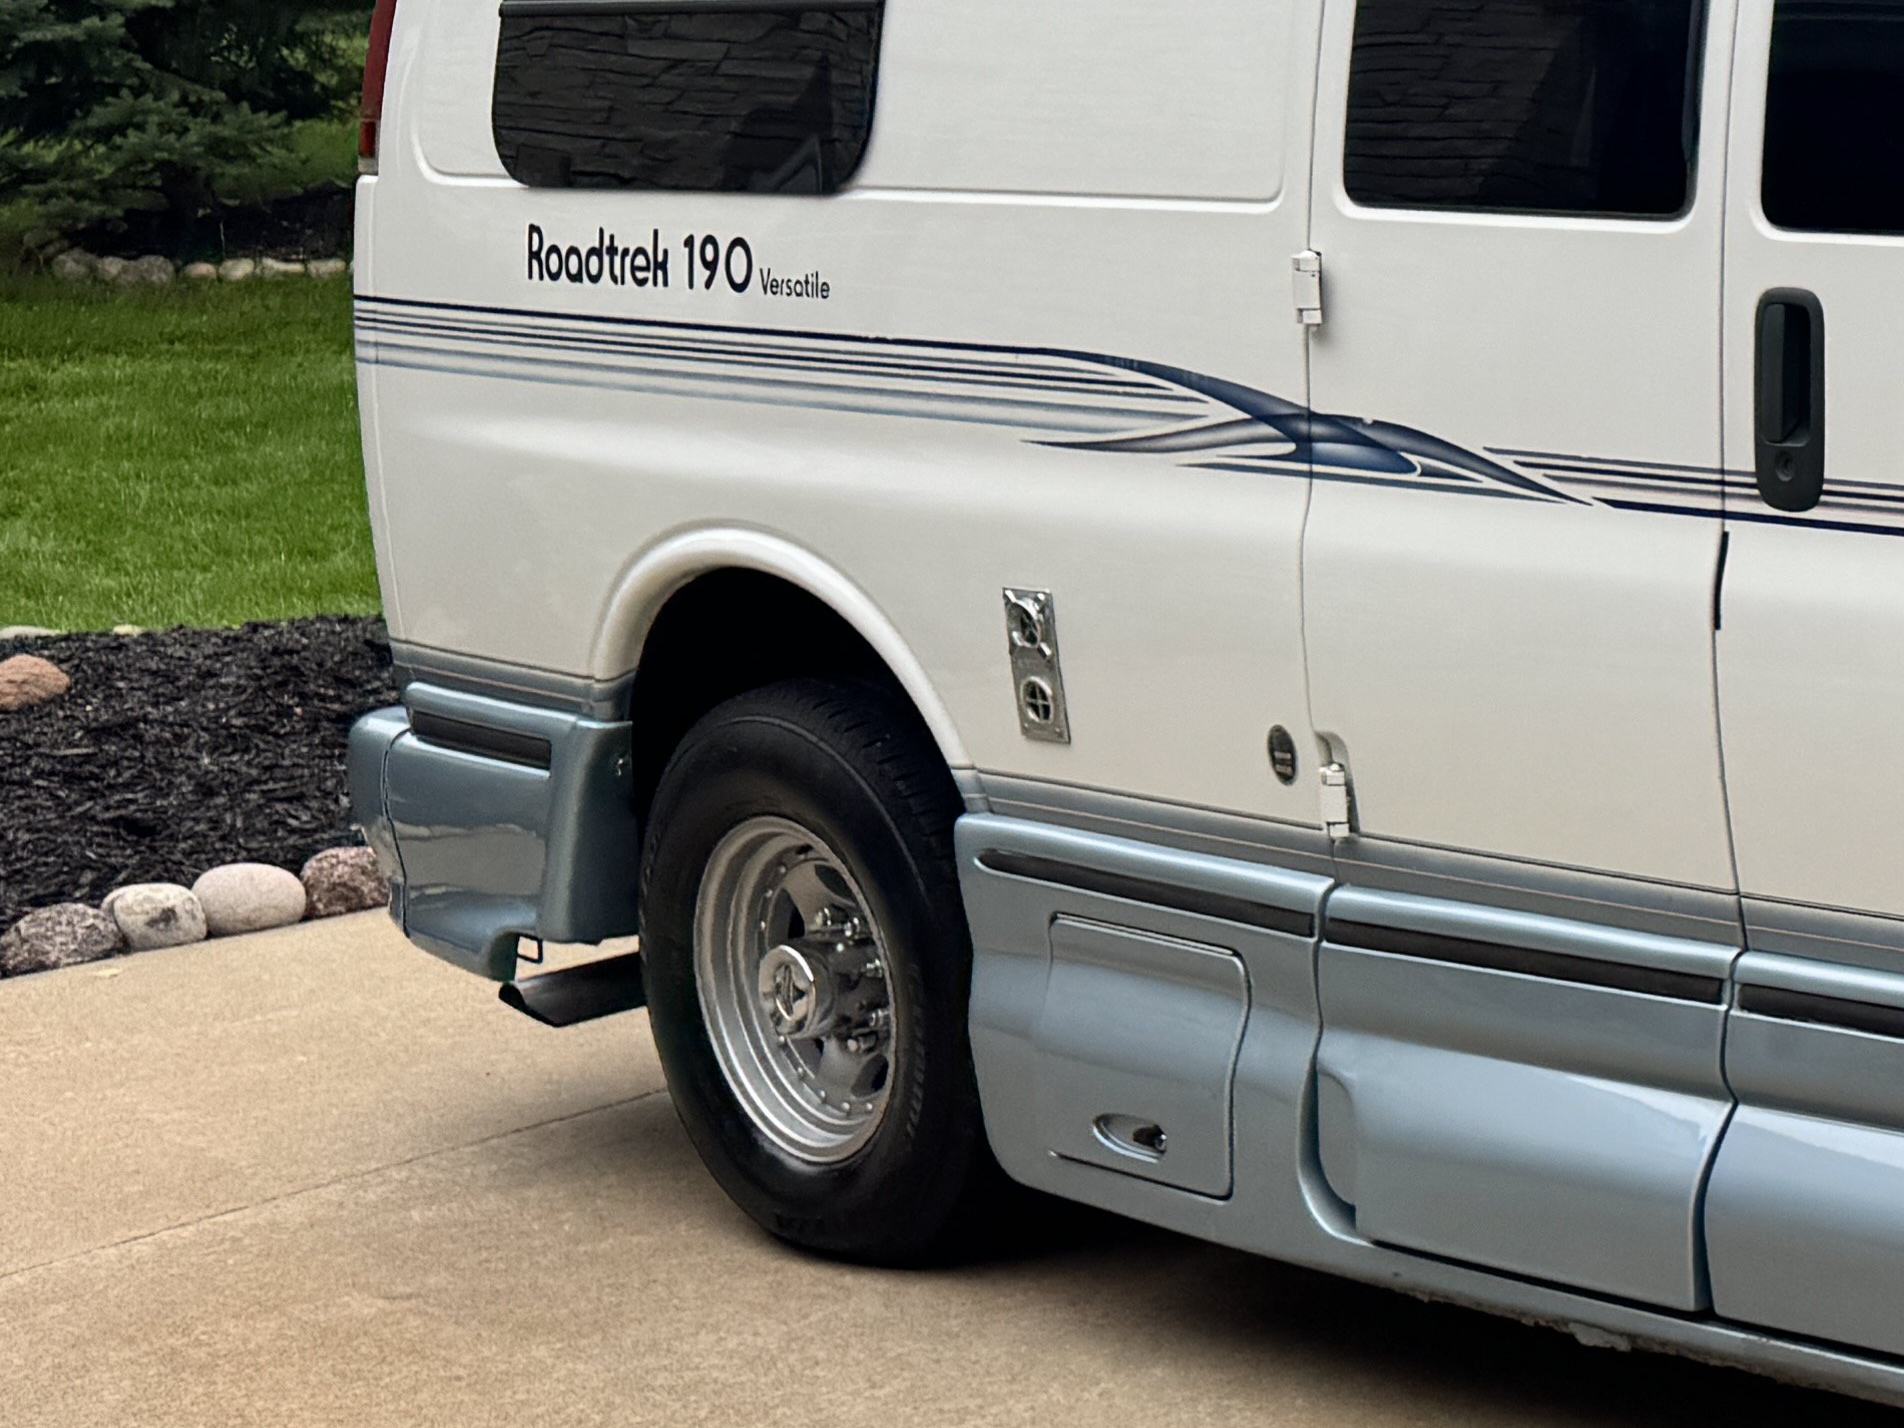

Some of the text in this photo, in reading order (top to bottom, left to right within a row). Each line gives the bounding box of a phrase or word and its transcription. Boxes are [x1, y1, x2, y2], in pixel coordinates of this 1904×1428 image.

[527, 223, 831, 300] Roadtrek 190 Versatile
